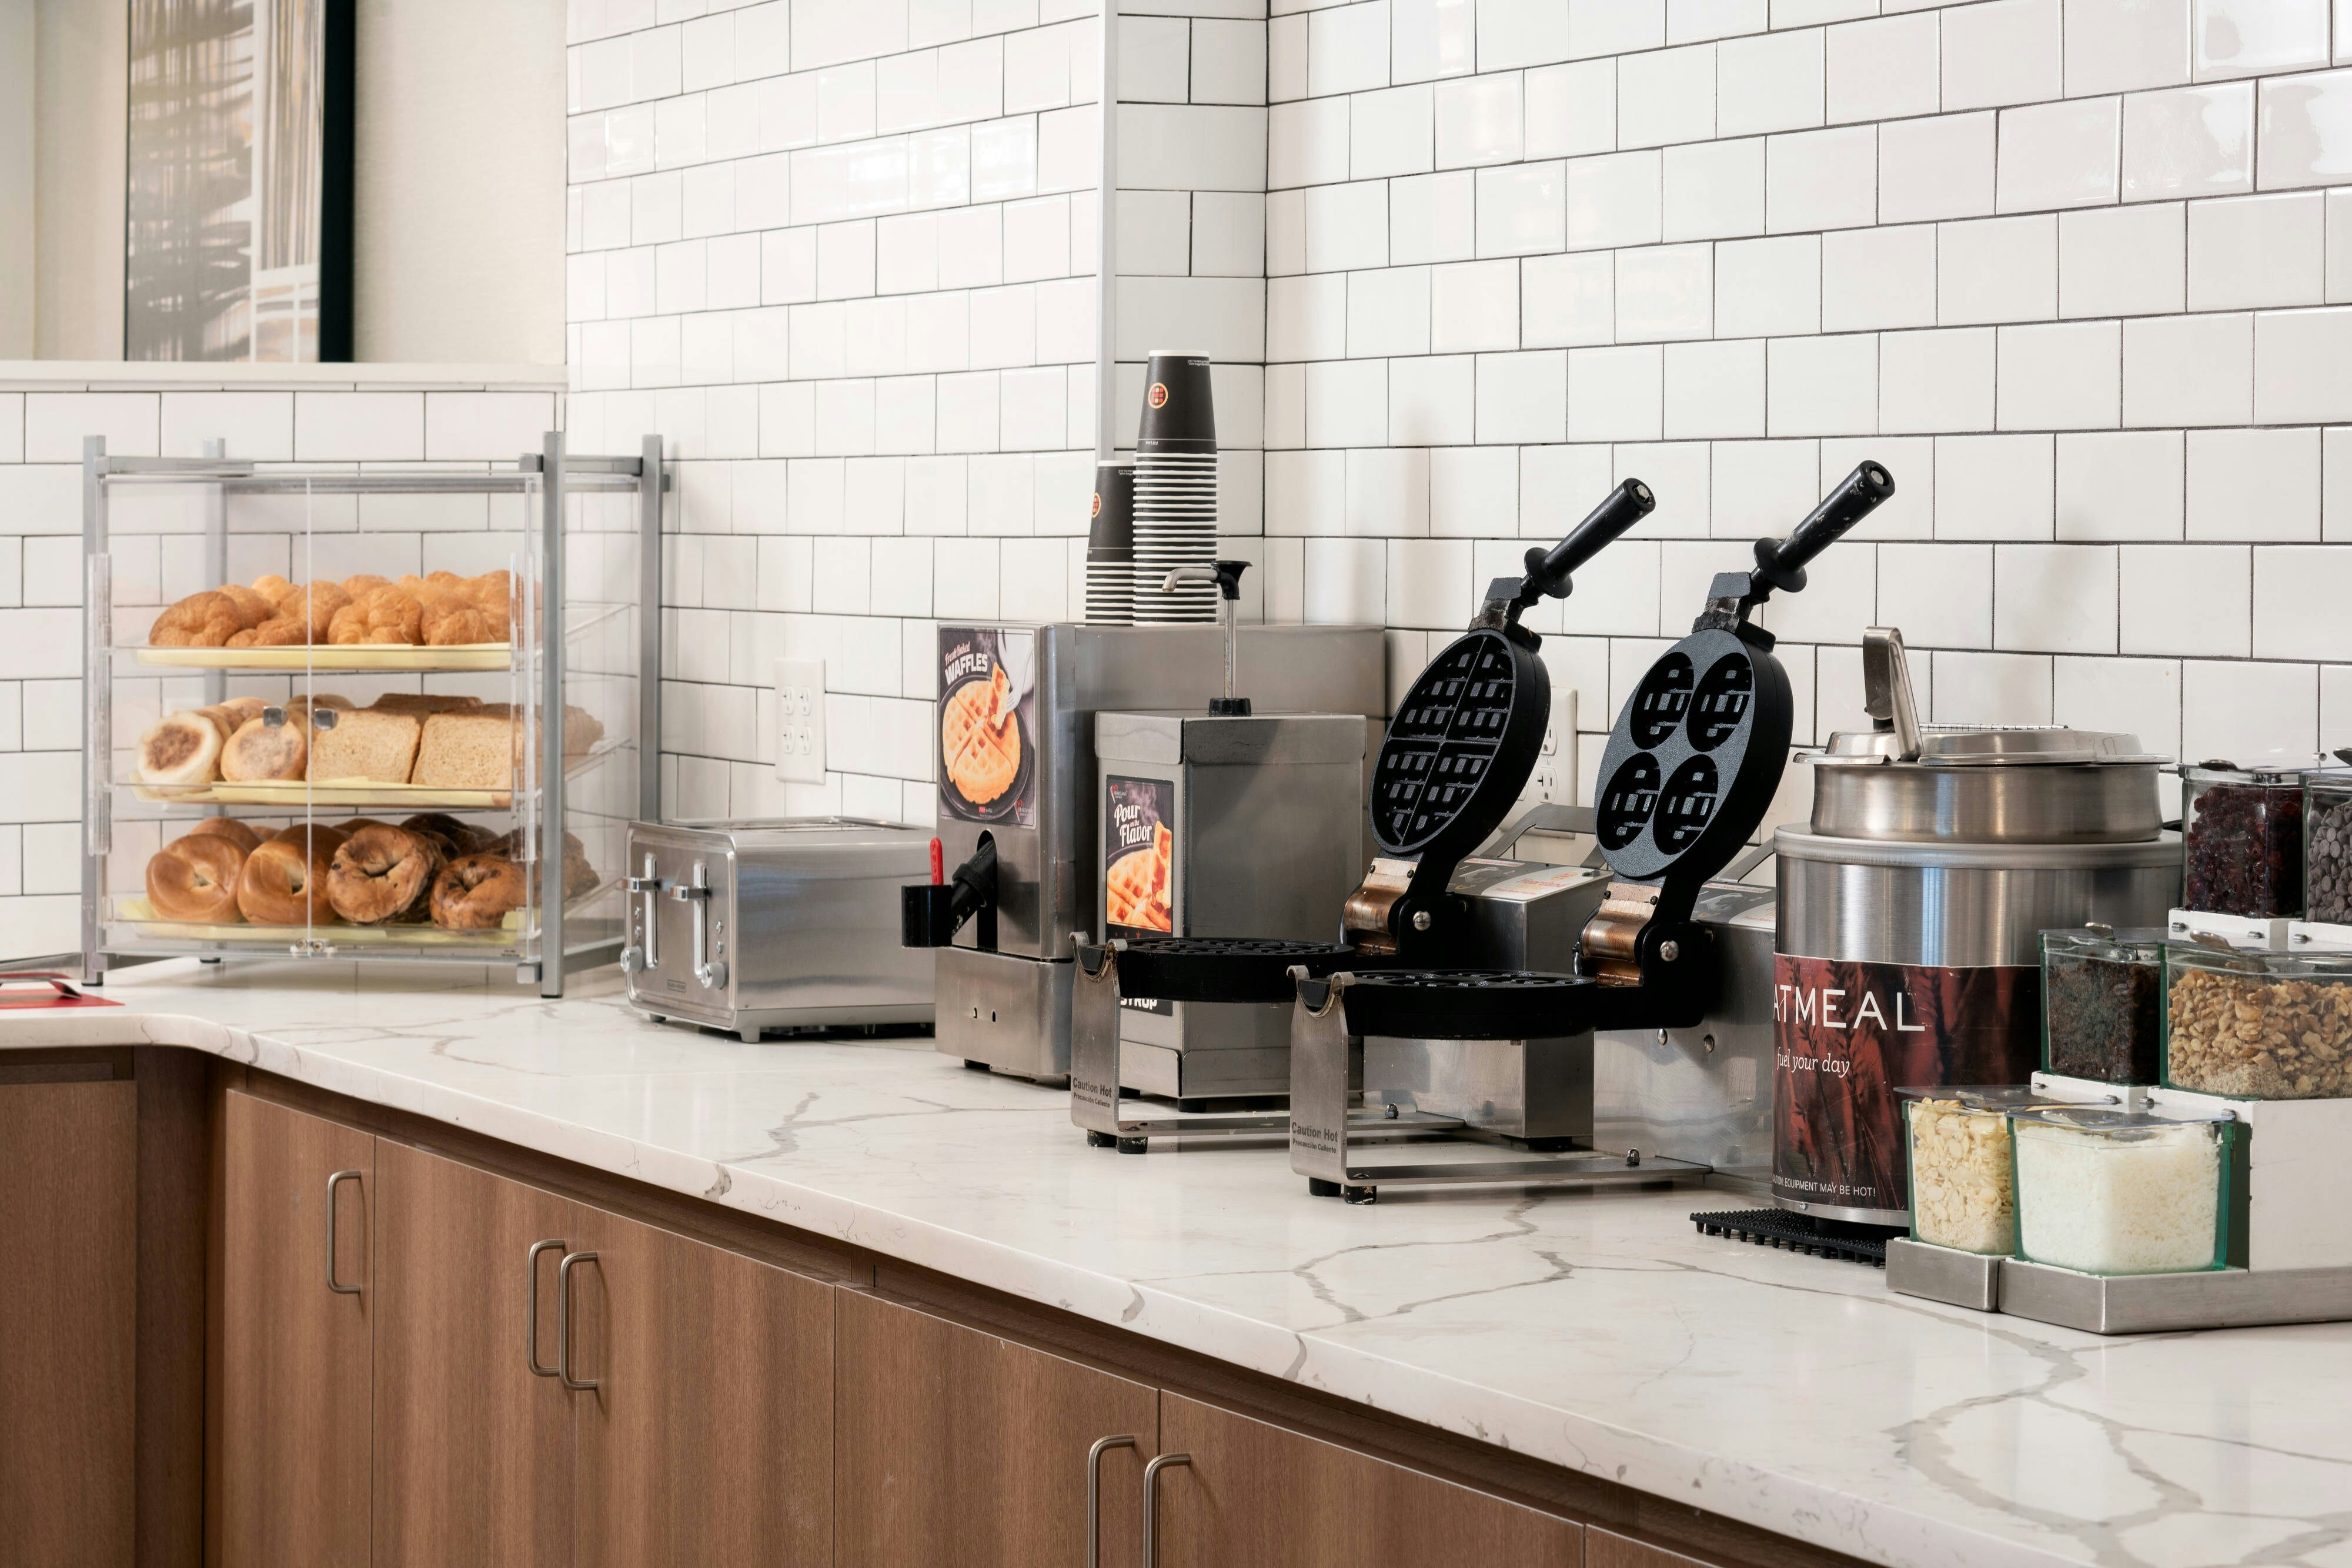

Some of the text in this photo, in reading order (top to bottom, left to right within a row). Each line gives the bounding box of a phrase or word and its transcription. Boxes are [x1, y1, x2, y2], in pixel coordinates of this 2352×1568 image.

[945, 641, 970, 666] Fresh Baked
[945, 653, 988, 686] WAFFLES
[1114, 804, 1141, 828] Pour
[1120, 824, 1152, 847] Flavor
[1773, 983, 1925, 1032] ATMEAL
[1777, 1047, 1850, 1078] fuel your day
[1073, 1077, 1112, 1098] Caution Hot
[1074, 1092, 1110, 1108] Precaución Caliente
[1292, 1122, 1338, 1142] Caution Hot
[1293, 1138, 1336, 1154] Precaución Caliente
[1785, 1178, 1818, 1192] EQUIPMENT
[1820, 1183, 1837, 1193] MAY
[1839, 1185, 1850, 1195] BE
[1853, 1186, 1876, 1197] HOT!
